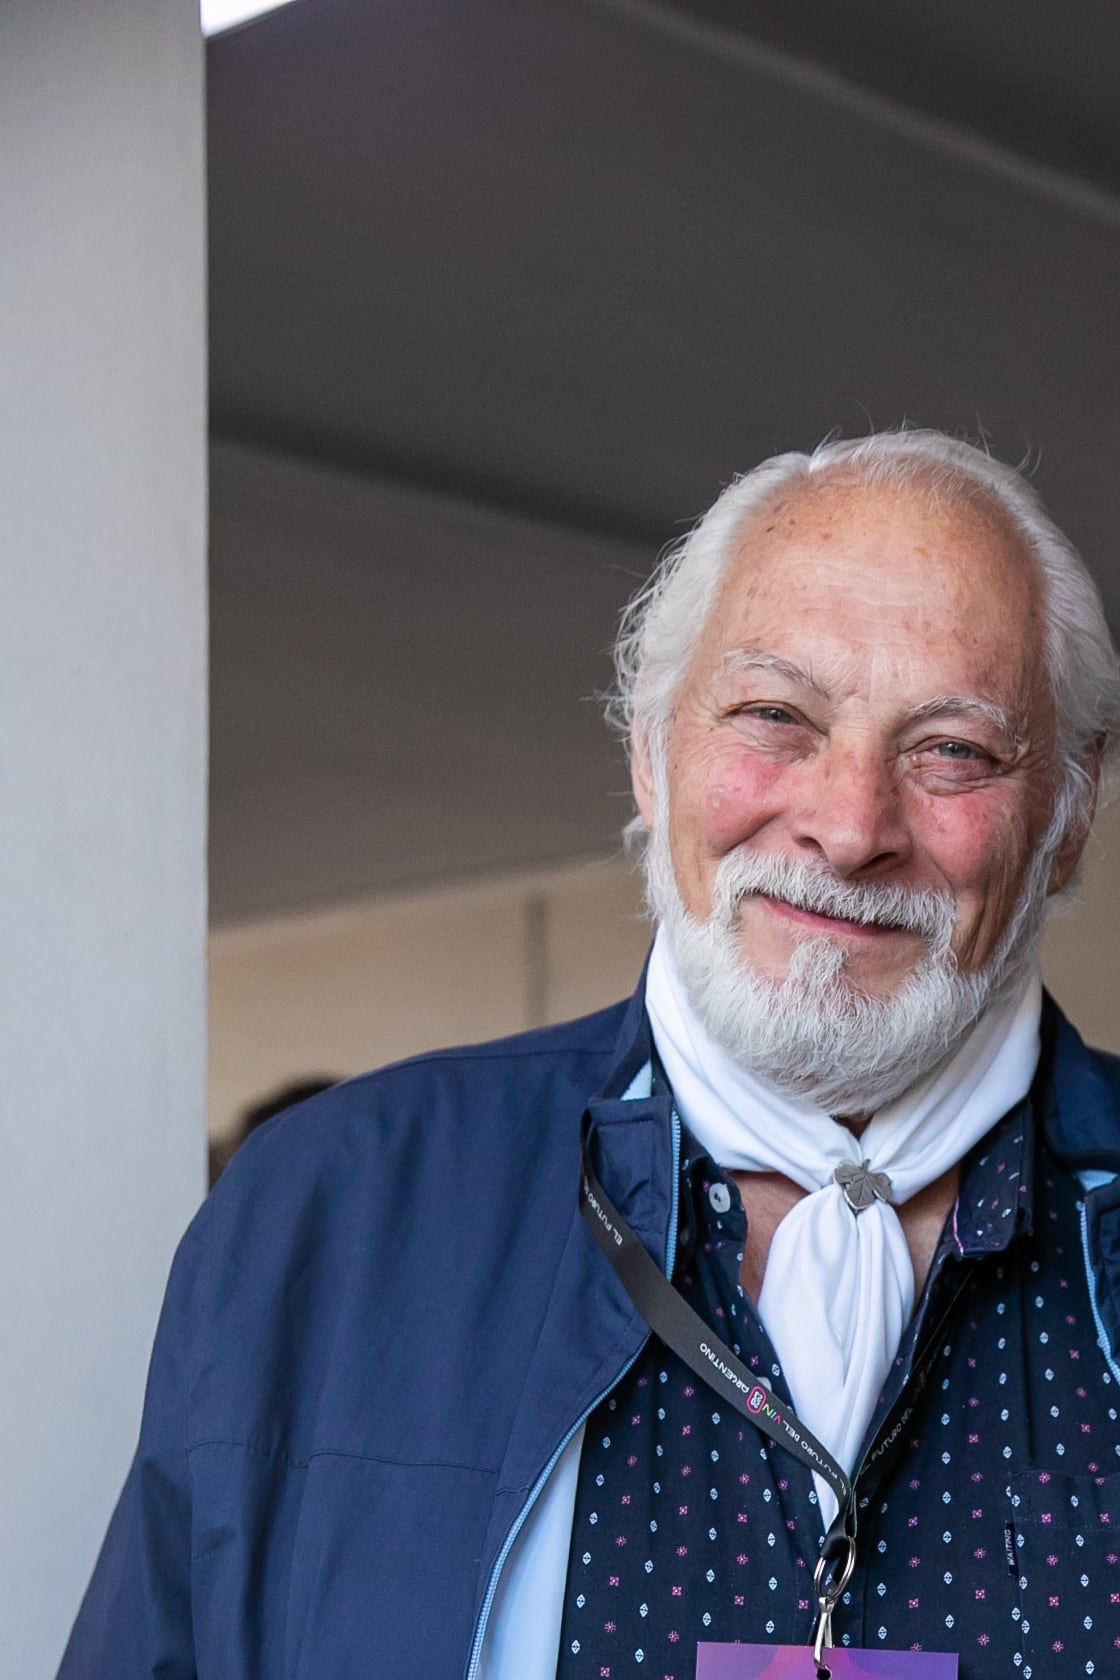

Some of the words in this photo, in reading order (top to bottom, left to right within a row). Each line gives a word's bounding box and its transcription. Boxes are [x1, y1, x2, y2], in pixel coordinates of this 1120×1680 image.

[700, 1343, 749, 1393] ARGENTINO
[783, 1420, 800, 1442] DEL
[801, 1441, 838, 1479] FUTURO
[1005, 1529, 1015, 1566] WAITING
